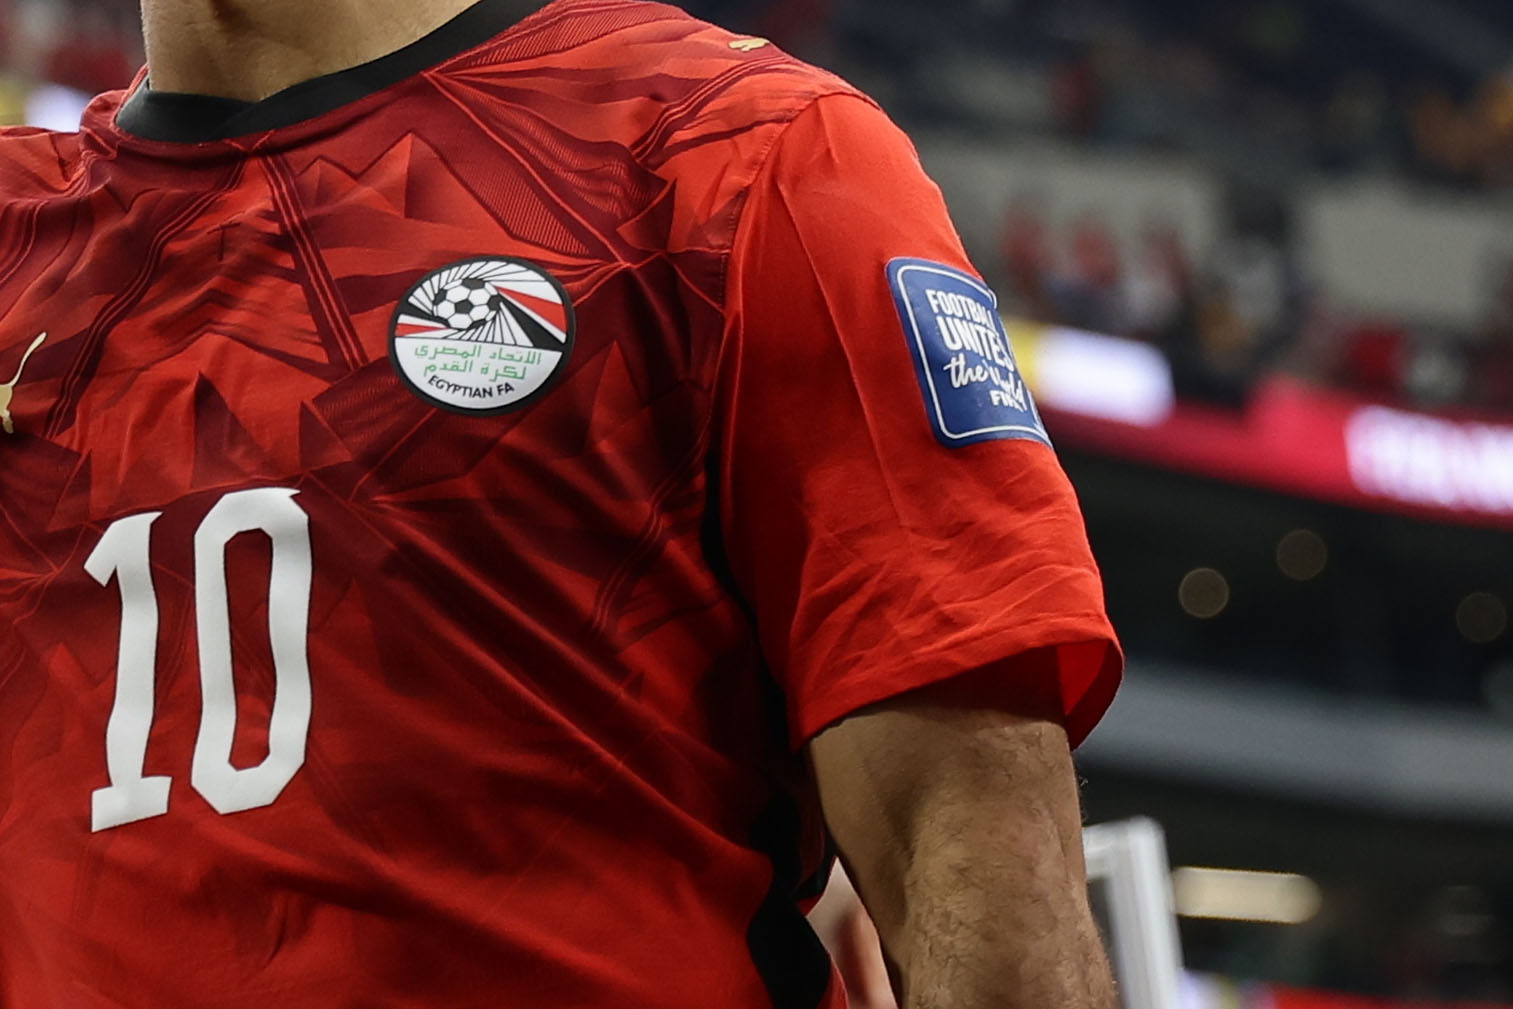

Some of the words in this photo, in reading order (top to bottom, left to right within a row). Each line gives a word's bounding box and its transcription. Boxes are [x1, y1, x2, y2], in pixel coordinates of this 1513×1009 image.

[489, 347, 542, 365] الاتحاد
[423, 360, 473, 377] القدم
[480, 363, 527, 382] لكرة
[943, 353, 988, 388] the
[428, 374, 493, 398] EGYPTIAN
[496, 381, 515, 395] FA
[84, 487, 312, 832] 10
